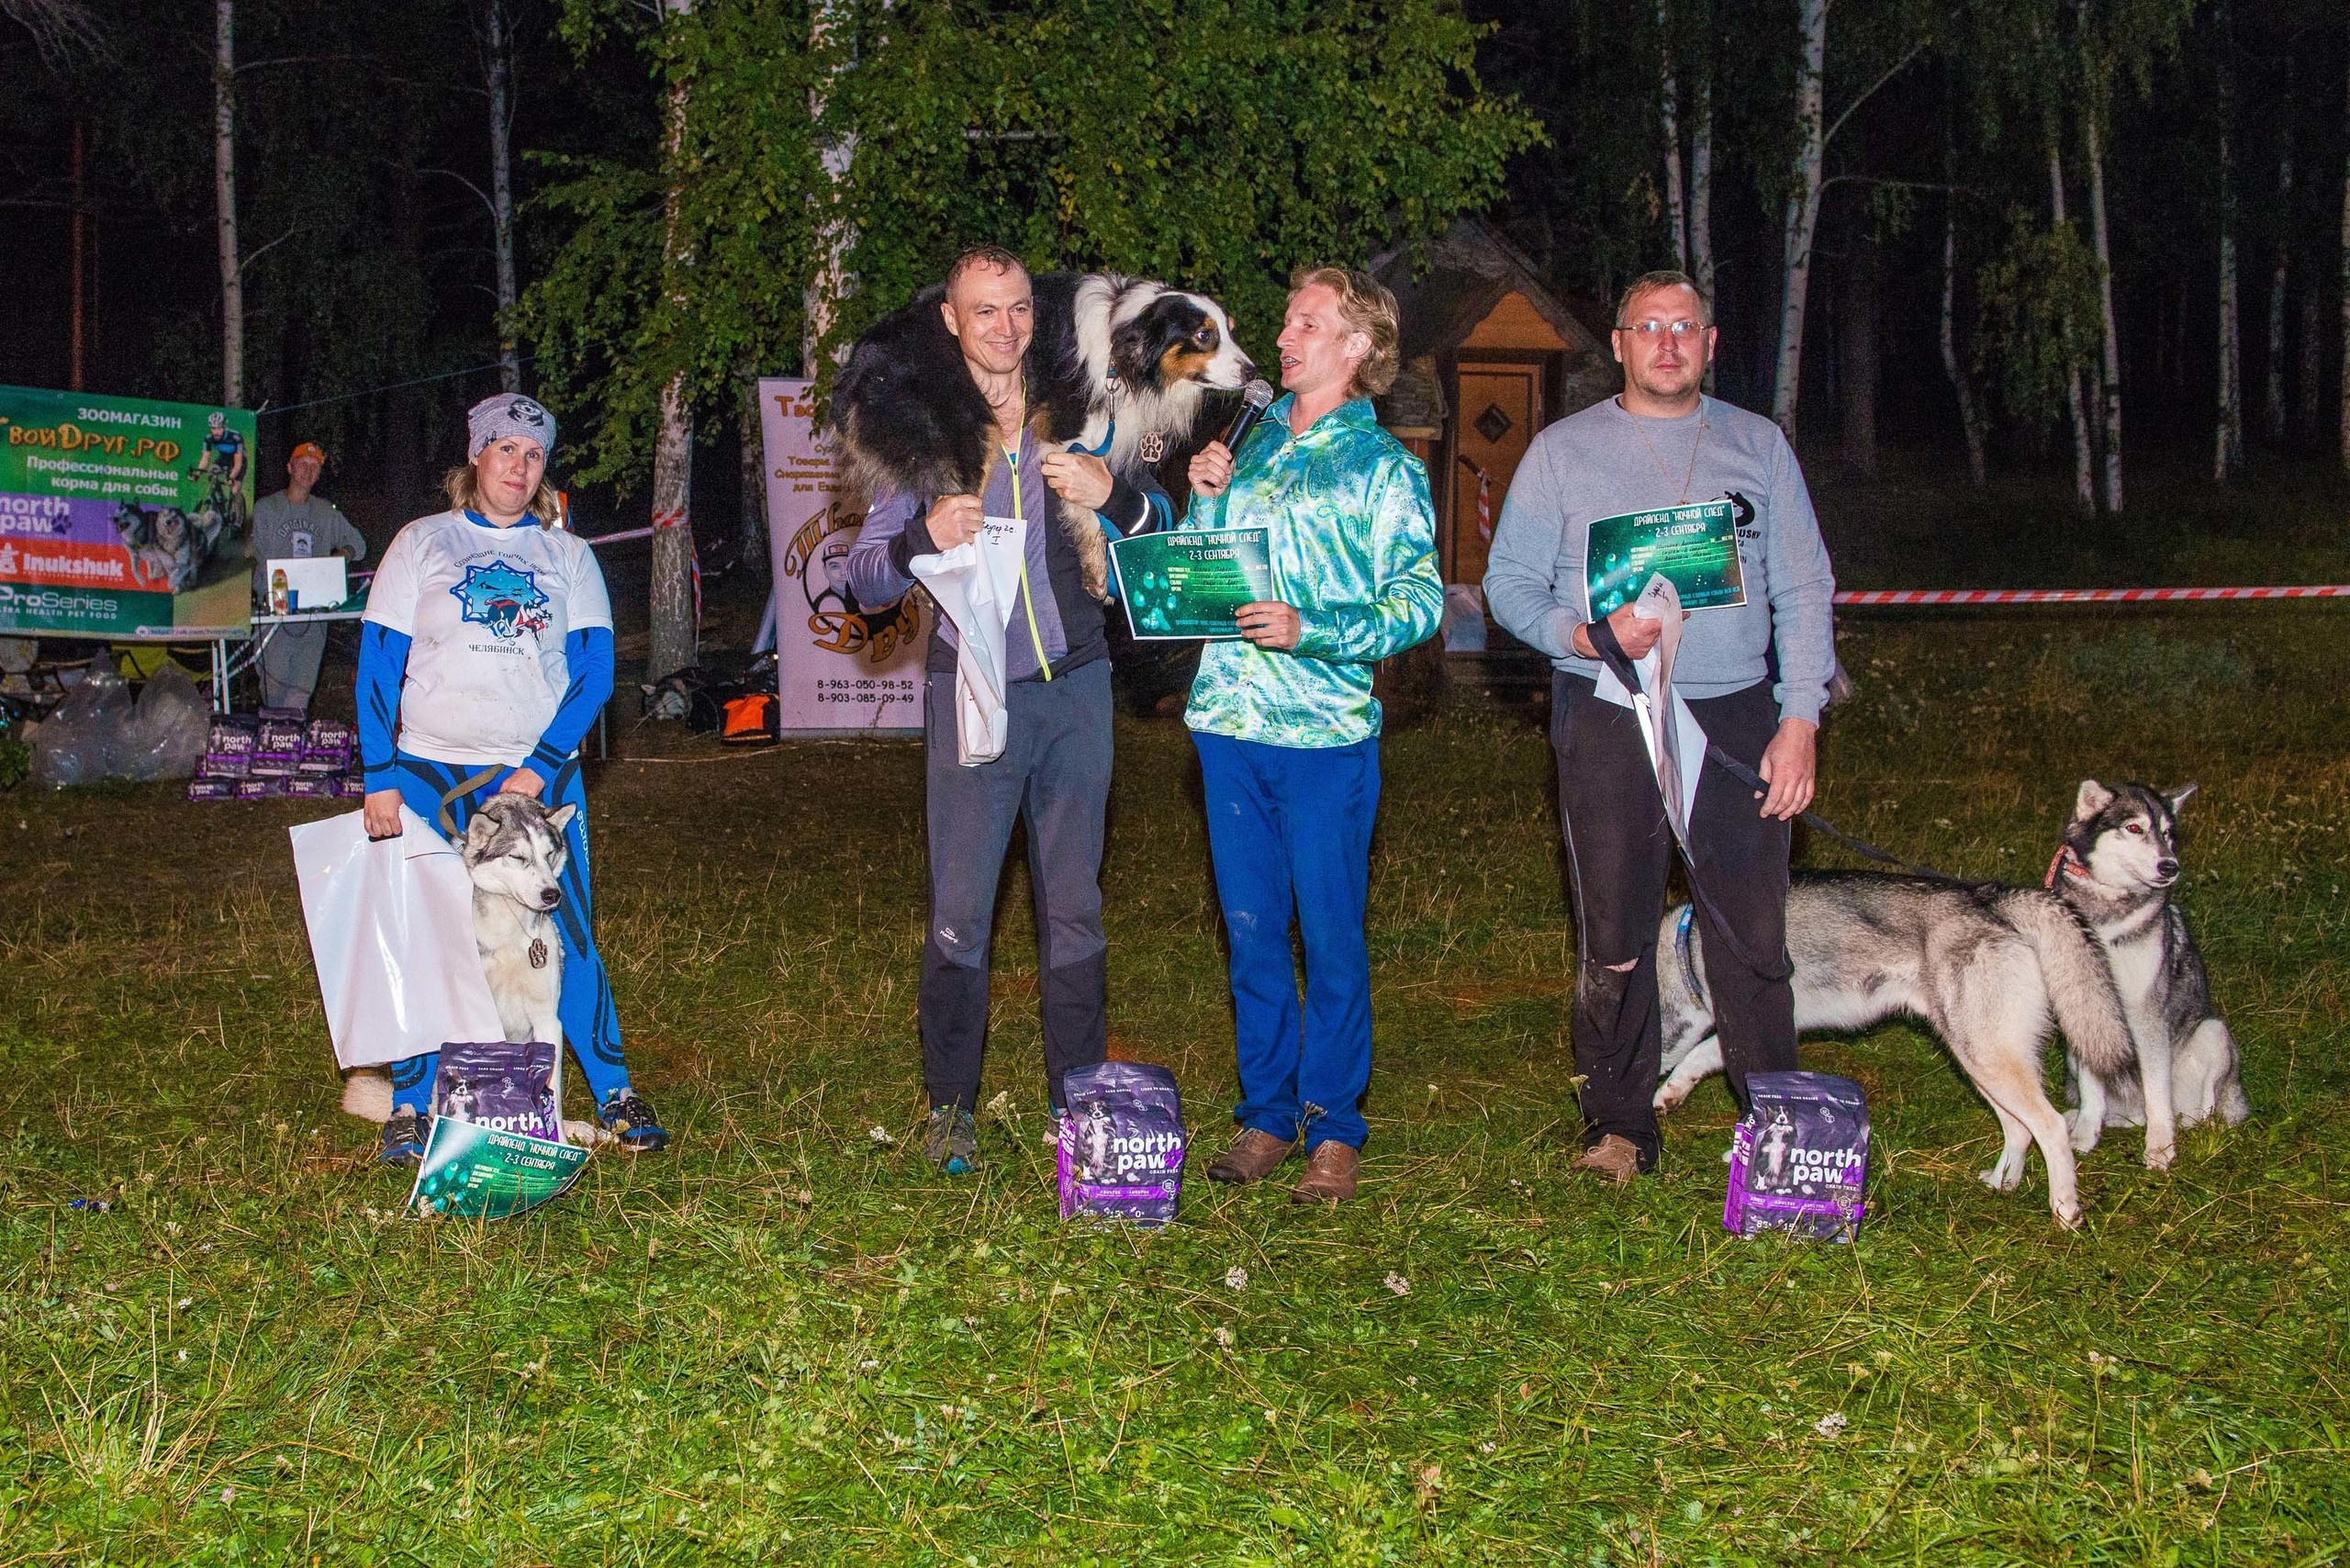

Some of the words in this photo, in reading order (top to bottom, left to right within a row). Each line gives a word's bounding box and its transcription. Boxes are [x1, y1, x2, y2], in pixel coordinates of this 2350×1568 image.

[77, 407, 182, 429] ЗООМАГАЗИН
[27, 454, 179, 481] Профессиональные
[51, 476, 99, 491] корма
[102, 481, 131, 493] для
[135, 485, 178, 497] собак
[0, 514, 52, 535] paw
[1633, 514, 1670, 527] ДРАЙЛЕНД
[1704, 505, 1726, 518] СЛЕД"
[277, 519, 321, 540] ORIGINAL
[1167, 535, 1203, 546] ДРАЙЛЕНД
[1239, 531, 1261, 543] СЛЕД"
[1655, 527, 1669, 538] 2-3
[1672, 524, 1706, 535] СЕНТЯБРЯ
[1189, 550, 1203, 560] 2-3
[1204, 549, 1239, 560] СЕНТЯБРЯ
[26, 607, 63, 617] HEALTH
[67, 610, 85, 618] PET
[90, 611, 118, 620] FOOD
[468, 644, 524, 655] ЧЕЛЯБИНСК
[817, 679, 913, 689] 8-963-050-98-52
[817, 693, 914, 703] 8-903-085-09-49
[222, 735, 252, 745] north
[272, 734, 300, 743] north
[320, 730, 348, 739] north
[476, 1112, 543, 1131] north
[487, 1135, 525, 1152] ДРАЙЛЕНД
[529, 1141, 558, 1159] "НОЧНОЙ
[559, 1148, 582, 1162] СЛЕД"
[1113, 1132, 1181, 1154] north
[504, 1153, 519, 1164] 2-3
[520, 1155, 556, 1171] СЕНТЯБРЯ
[1117, 1153, 1167, 1175] paw
[1790, 1148, 1862, 1168] north
[1793, 1165, 1843, 1185] paw
